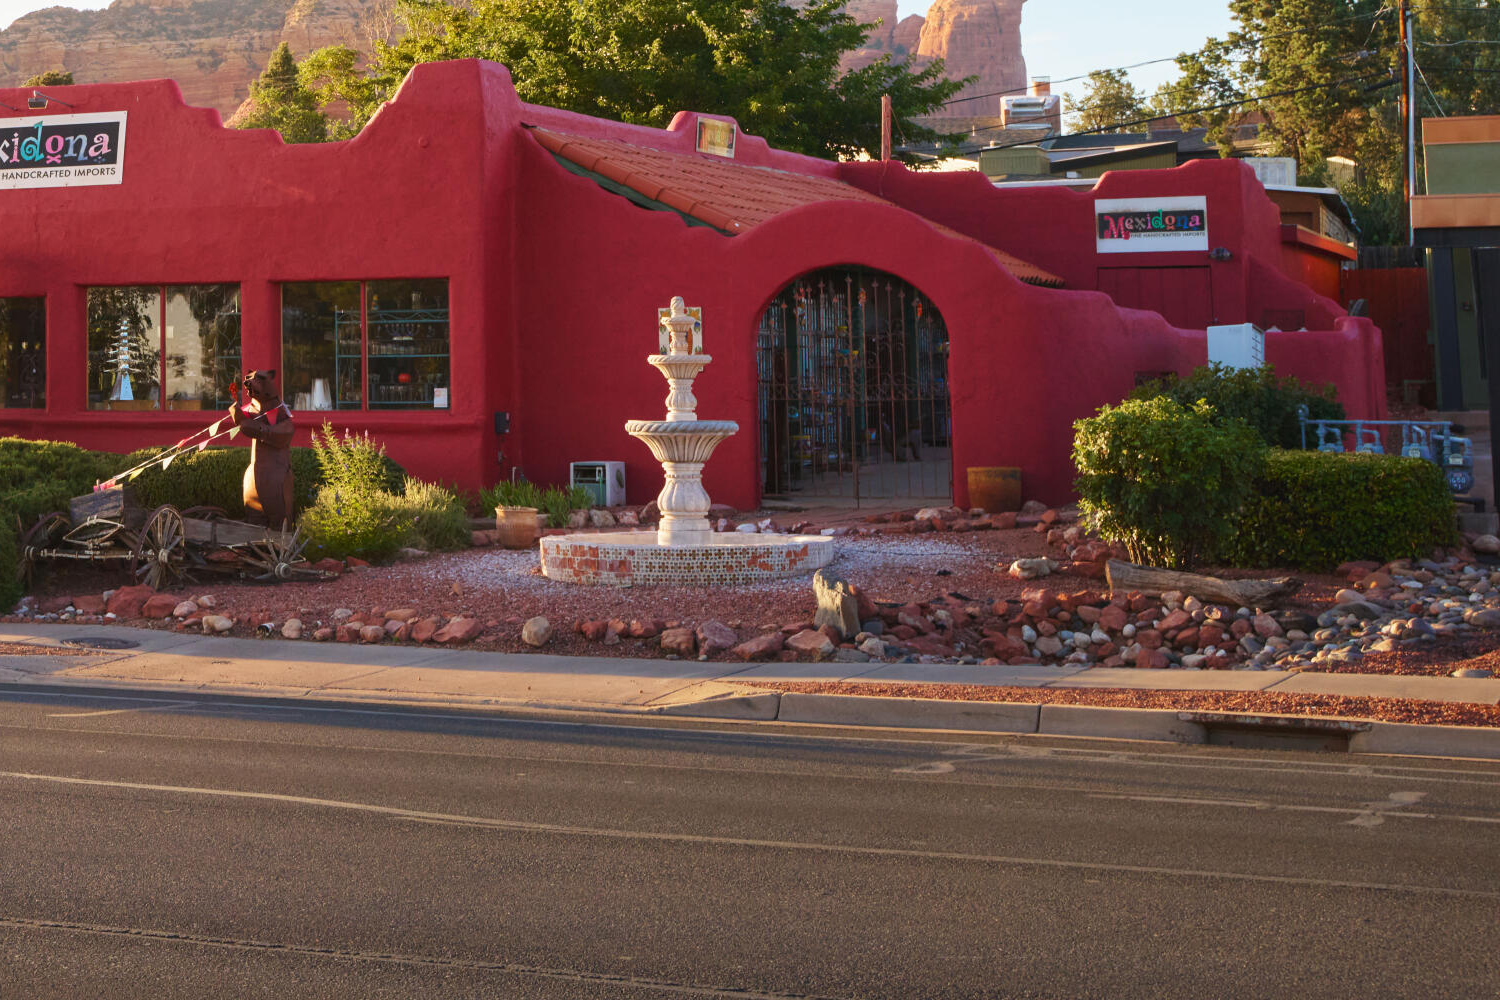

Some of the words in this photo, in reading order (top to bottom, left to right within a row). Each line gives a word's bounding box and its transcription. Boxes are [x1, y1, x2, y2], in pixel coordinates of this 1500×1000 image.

[1, 169, 71, 181] HANDCRAFTED
[74, 167, 116, 178] IMPORTS
[1104, 208, 1201, 240] Mexidona
